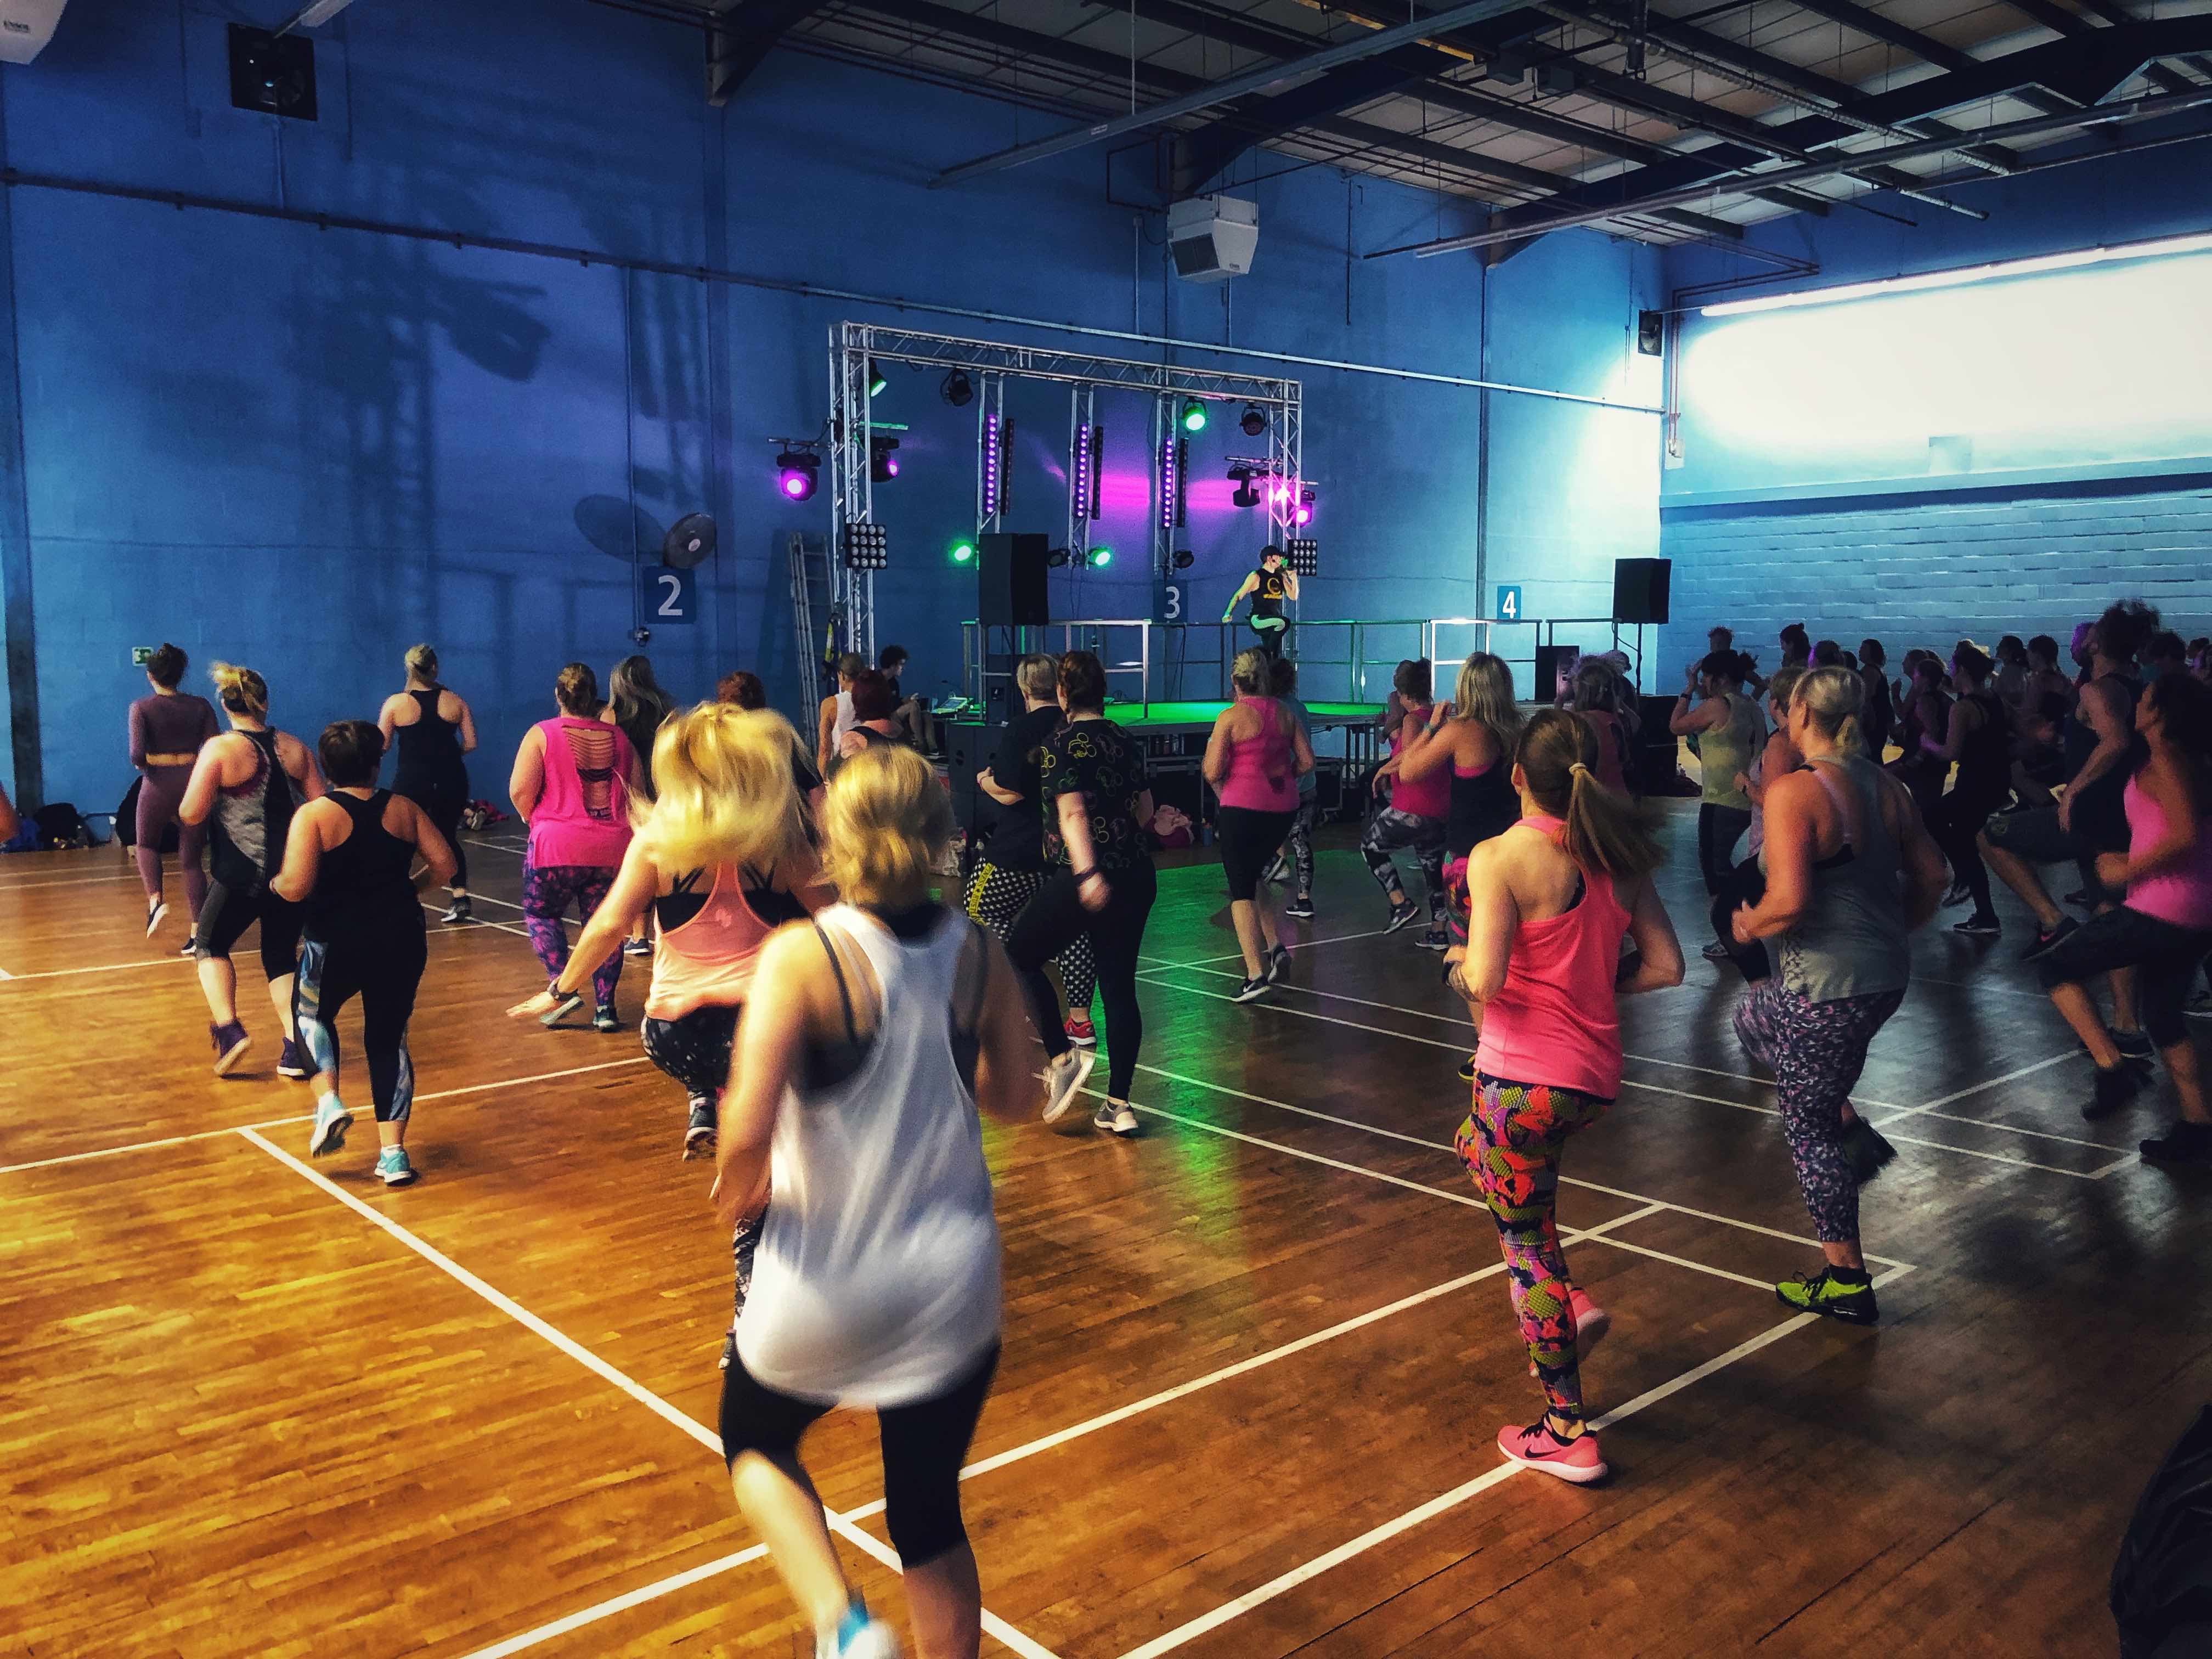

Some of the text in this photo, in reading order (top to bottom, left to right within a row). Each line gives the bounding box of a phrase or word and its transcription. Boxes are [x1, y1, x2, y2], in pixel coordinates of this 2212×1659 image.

[658, 574, 683, 616] 2
[1164, 586, 1180, 619] 3
[1502, 591, 1516, 619] 4
